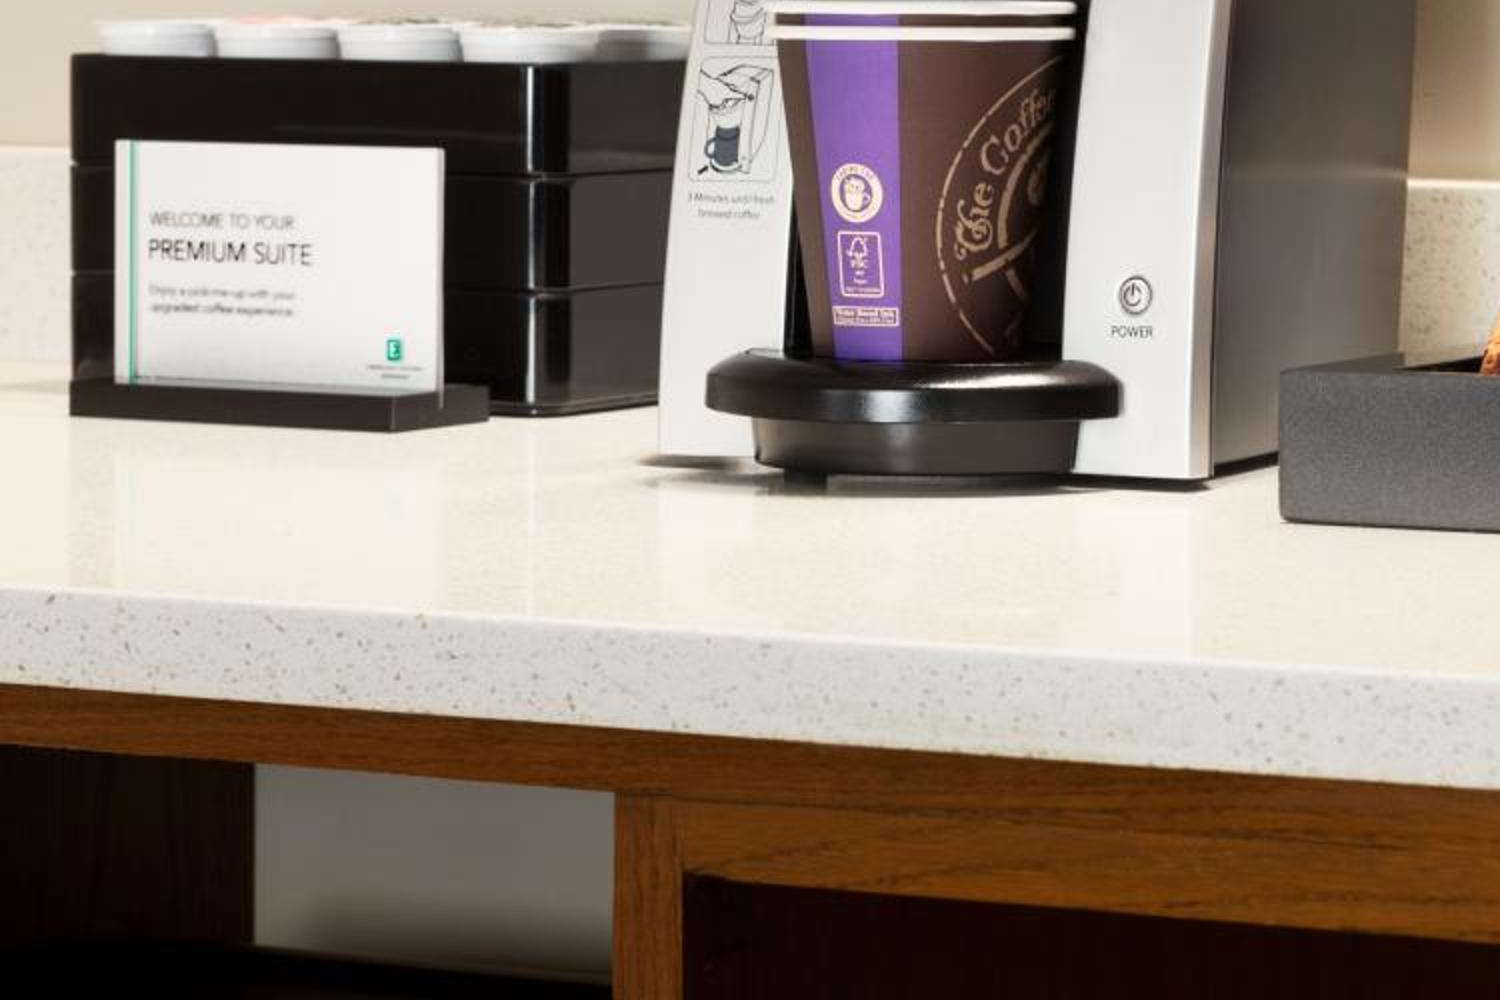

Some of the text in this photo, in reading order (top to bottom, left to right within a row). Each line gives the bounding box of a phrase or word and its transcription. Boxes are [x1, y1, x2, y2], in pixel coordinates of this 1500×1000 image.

[150, 211, 295, 230] WELCOME TO YOUR
[149, 238, 312, 266] PREMIUM SUITE
[202, 301, 233, 313] coffee
[1111, 325, 1152, 338] POWER
